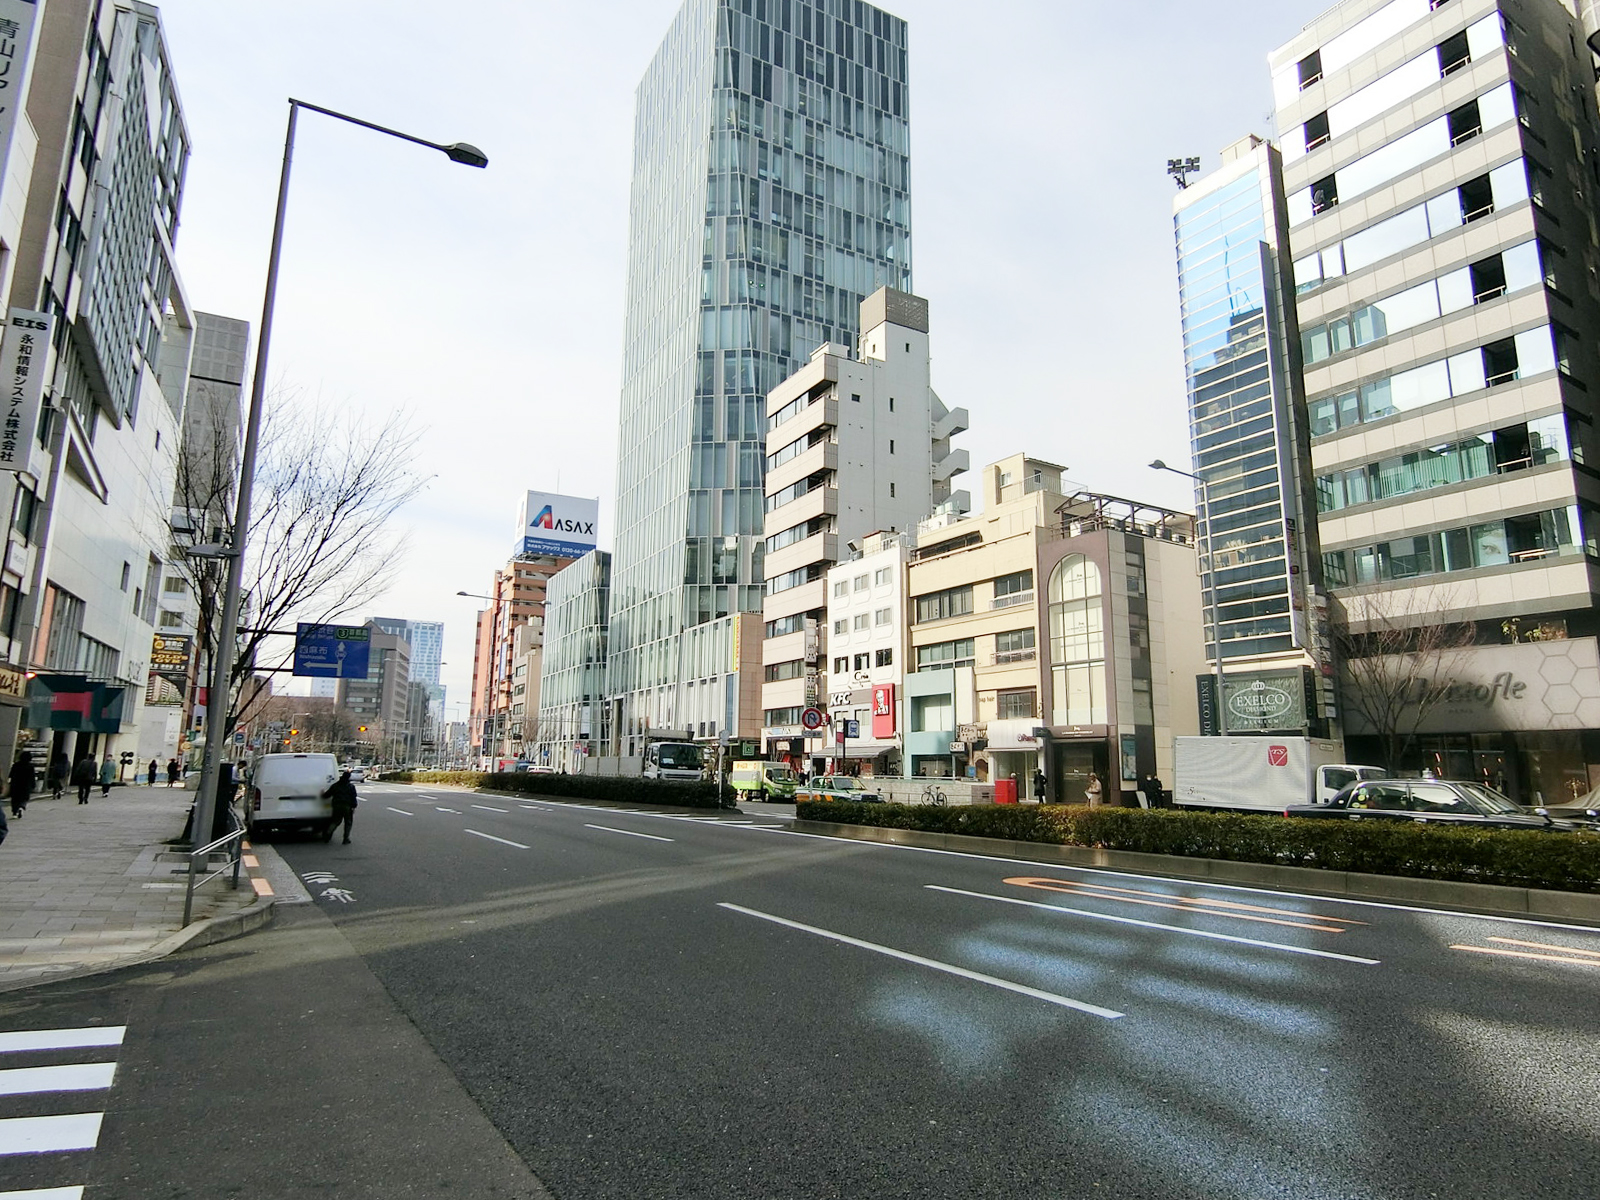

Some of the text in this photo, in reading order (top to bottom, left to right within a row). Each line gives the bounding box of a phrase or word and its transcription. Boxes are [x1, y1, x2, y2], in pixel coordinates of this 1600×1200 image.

[12, 317, 48, 331] EIS
[0, 334, 34, 463] 永和情報システム株式会社
[554, 518, 594, 535] ASAX
[829, 692, 851, 706] KFC
[1200, 681, 1211, 719] EXELCO
[1236, 693, 1286, 707] EXELCO
[1245, 705, 1277, 713] DIAMOND
